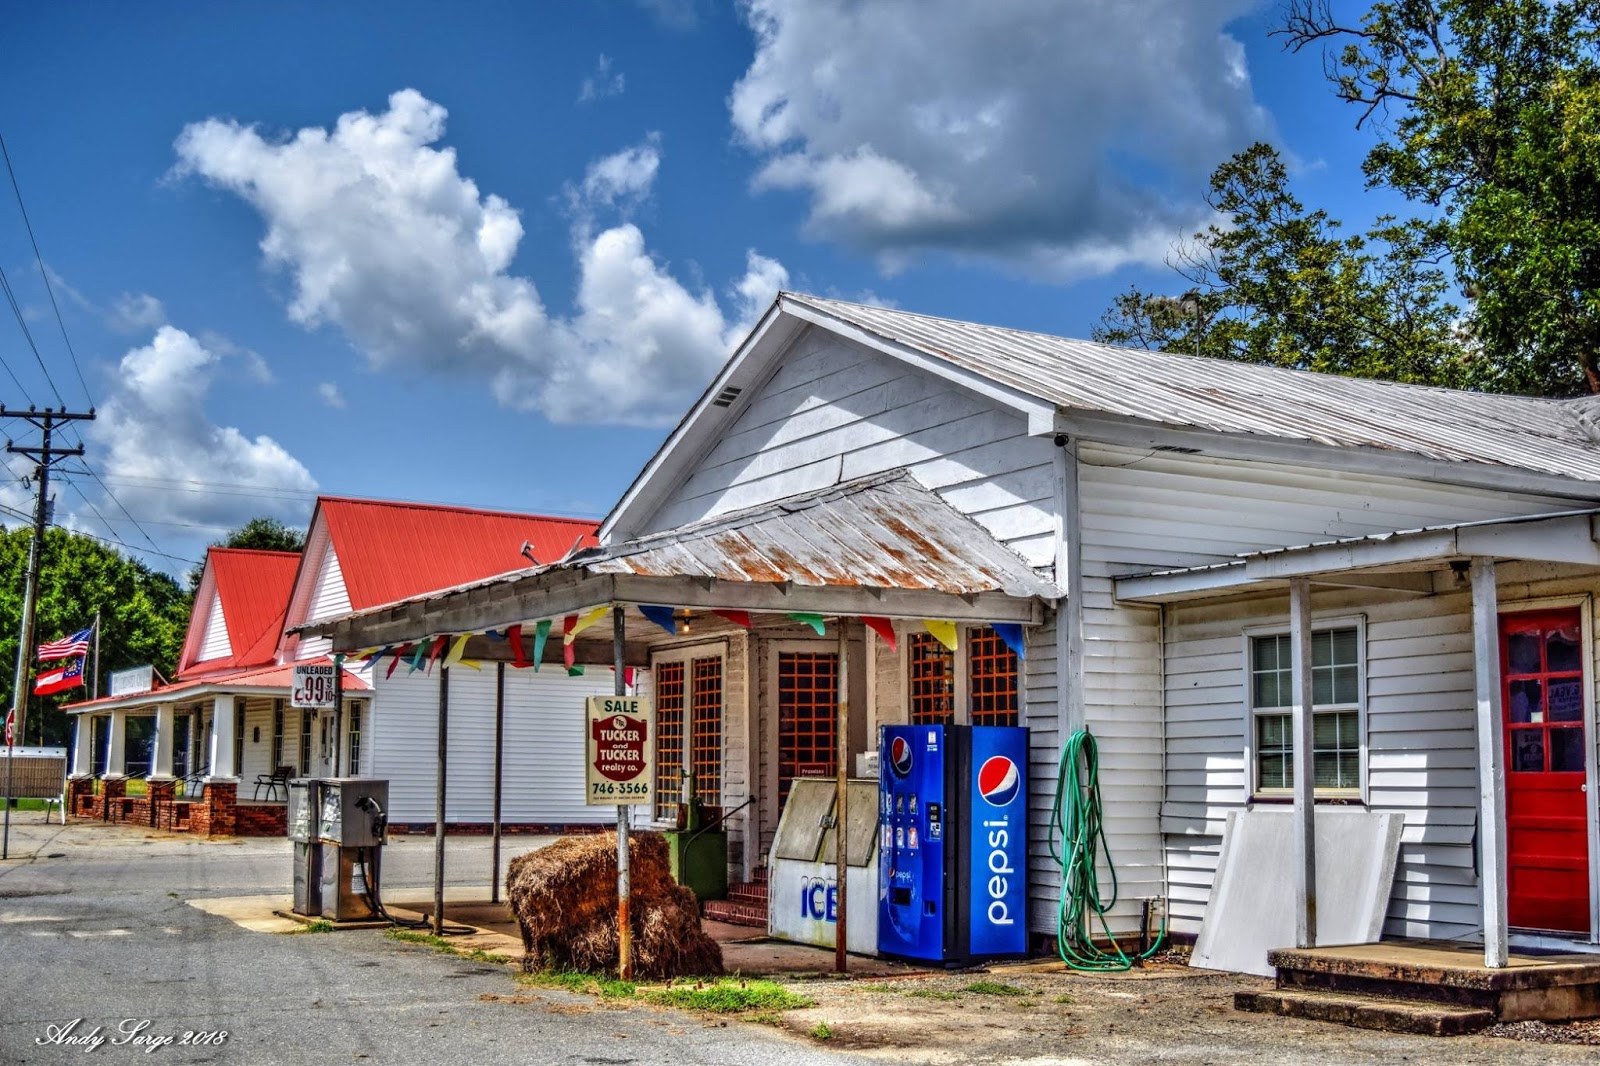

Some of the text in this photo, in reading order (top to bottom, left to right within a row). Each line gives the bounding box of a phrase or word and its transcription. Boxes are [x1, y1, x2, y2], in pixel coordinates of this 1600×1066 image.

[296, 665, 333, 675] UNLEADED
[604, 699, 638, 713] SALE
[600, 729, 640, 741] TUCKER
[600, 749, 640, 761] TUCKER
[601, 763, 625, 773] realty
[592, 782, 648, 794] 746-3566
[983, 820, 1014, 925] pepsi
[801, 875, 837, 923] ICE
